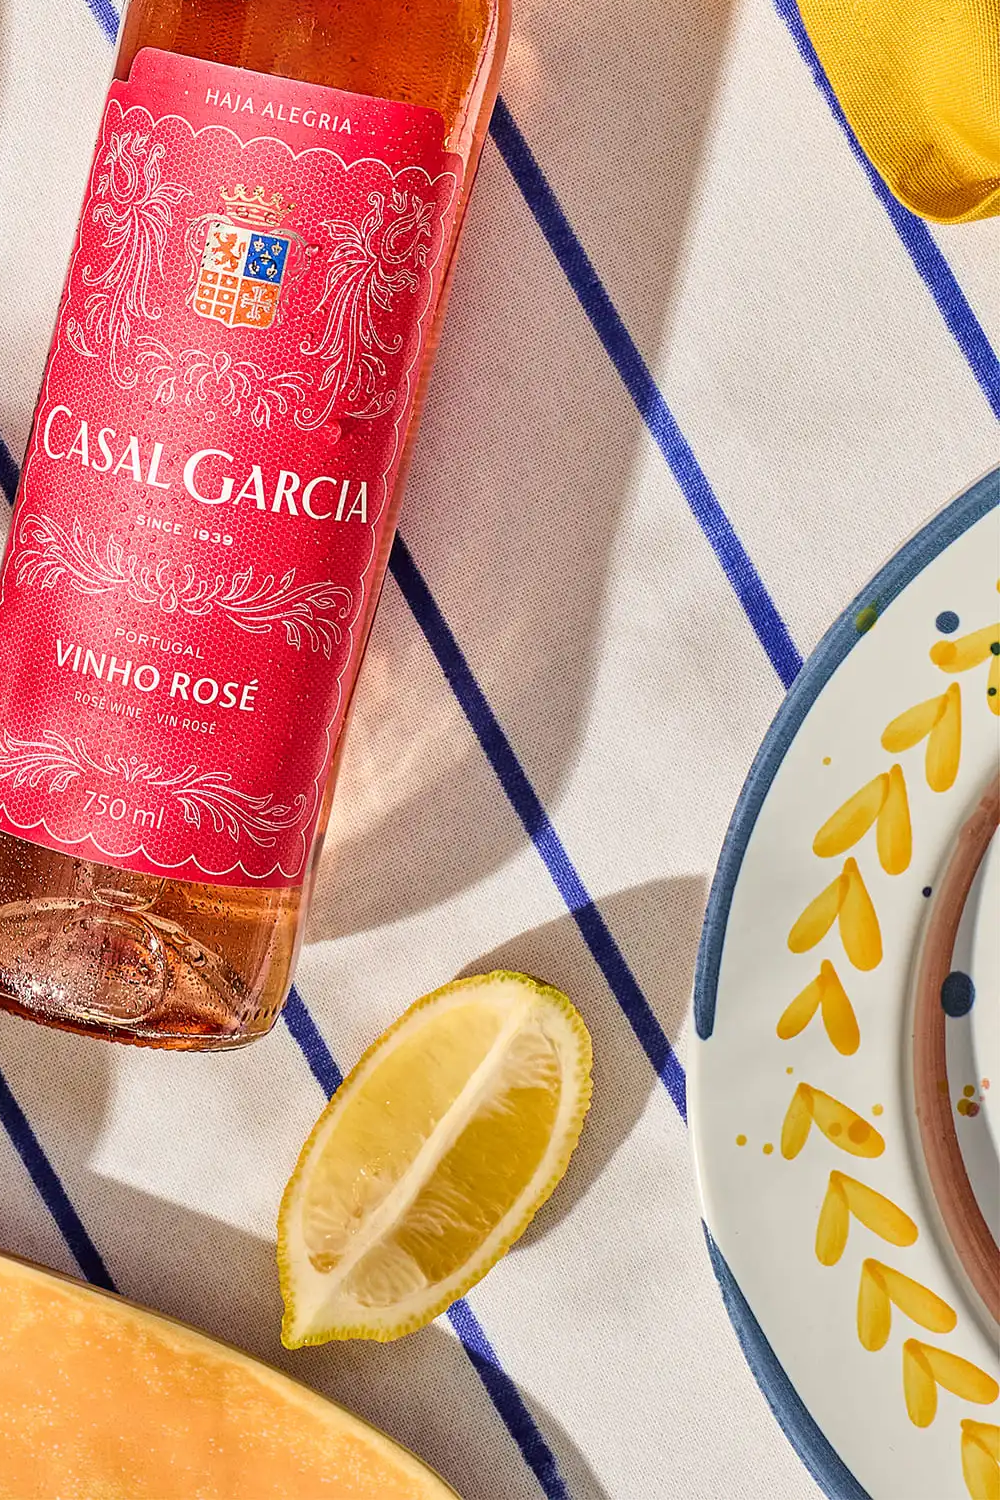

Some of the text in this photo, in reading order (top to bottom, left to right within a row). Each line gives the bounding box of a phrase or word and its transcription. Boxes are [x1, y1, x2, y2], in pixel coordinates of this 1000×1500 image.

[204, 88, 353, 135] HAJA ALEGRIA
[43, 404, 368, 524] CASAL GARCIA
[135, 514, 235, 547] SINCE 1939
[114, 627, 205, 659] PORTUGAL
[55, 639, 259, 711] VINHO ROSÉ
[73, 690, 217, 735] ROSÉ WINE VIN ROSÉ
[82, 790, 164, 829] 750 ml
